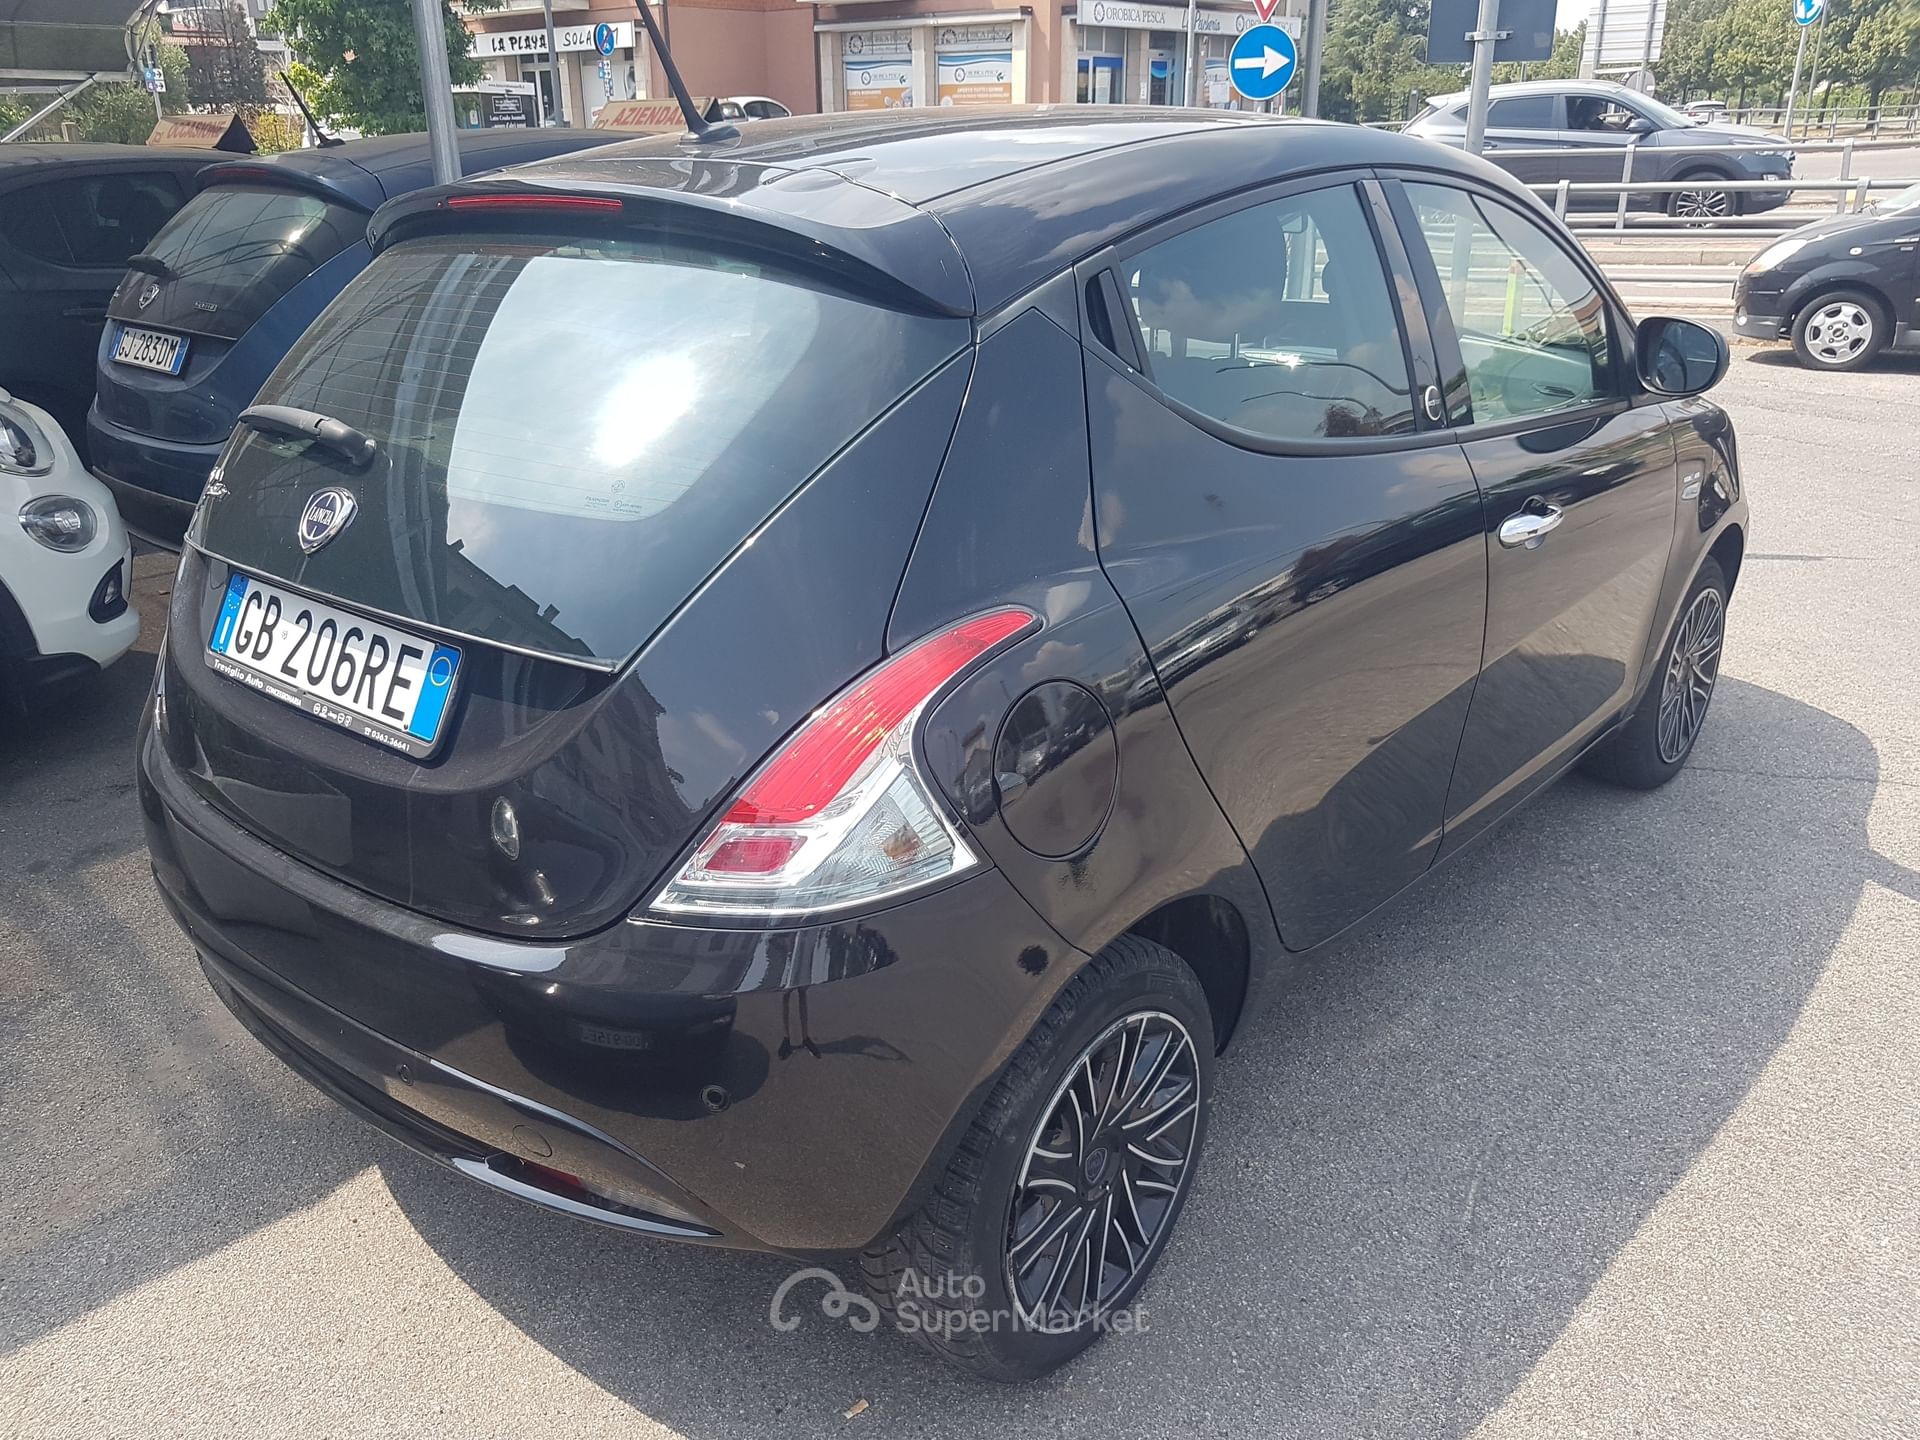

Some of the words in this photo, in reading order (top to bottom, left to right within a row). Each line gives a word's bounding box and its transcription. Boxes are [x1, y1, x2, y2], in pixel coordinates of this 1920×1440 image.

[1106, 7, 1141, 22] OROBICA
[1142, 10, 1166, 24] PESCA
[491, 37, 506, 53] LA
[508, 34, 548, 51] PLAYA
[133, 333, 179, 368] 283DM
[308, 506, 334, 526] LANCIA
[235, 590, 282, 661] GB
[280, 609, 424, 721] 206RE
[214, 659, 244, 680] Treviglio
[244, 673, 264, 689] Auto
